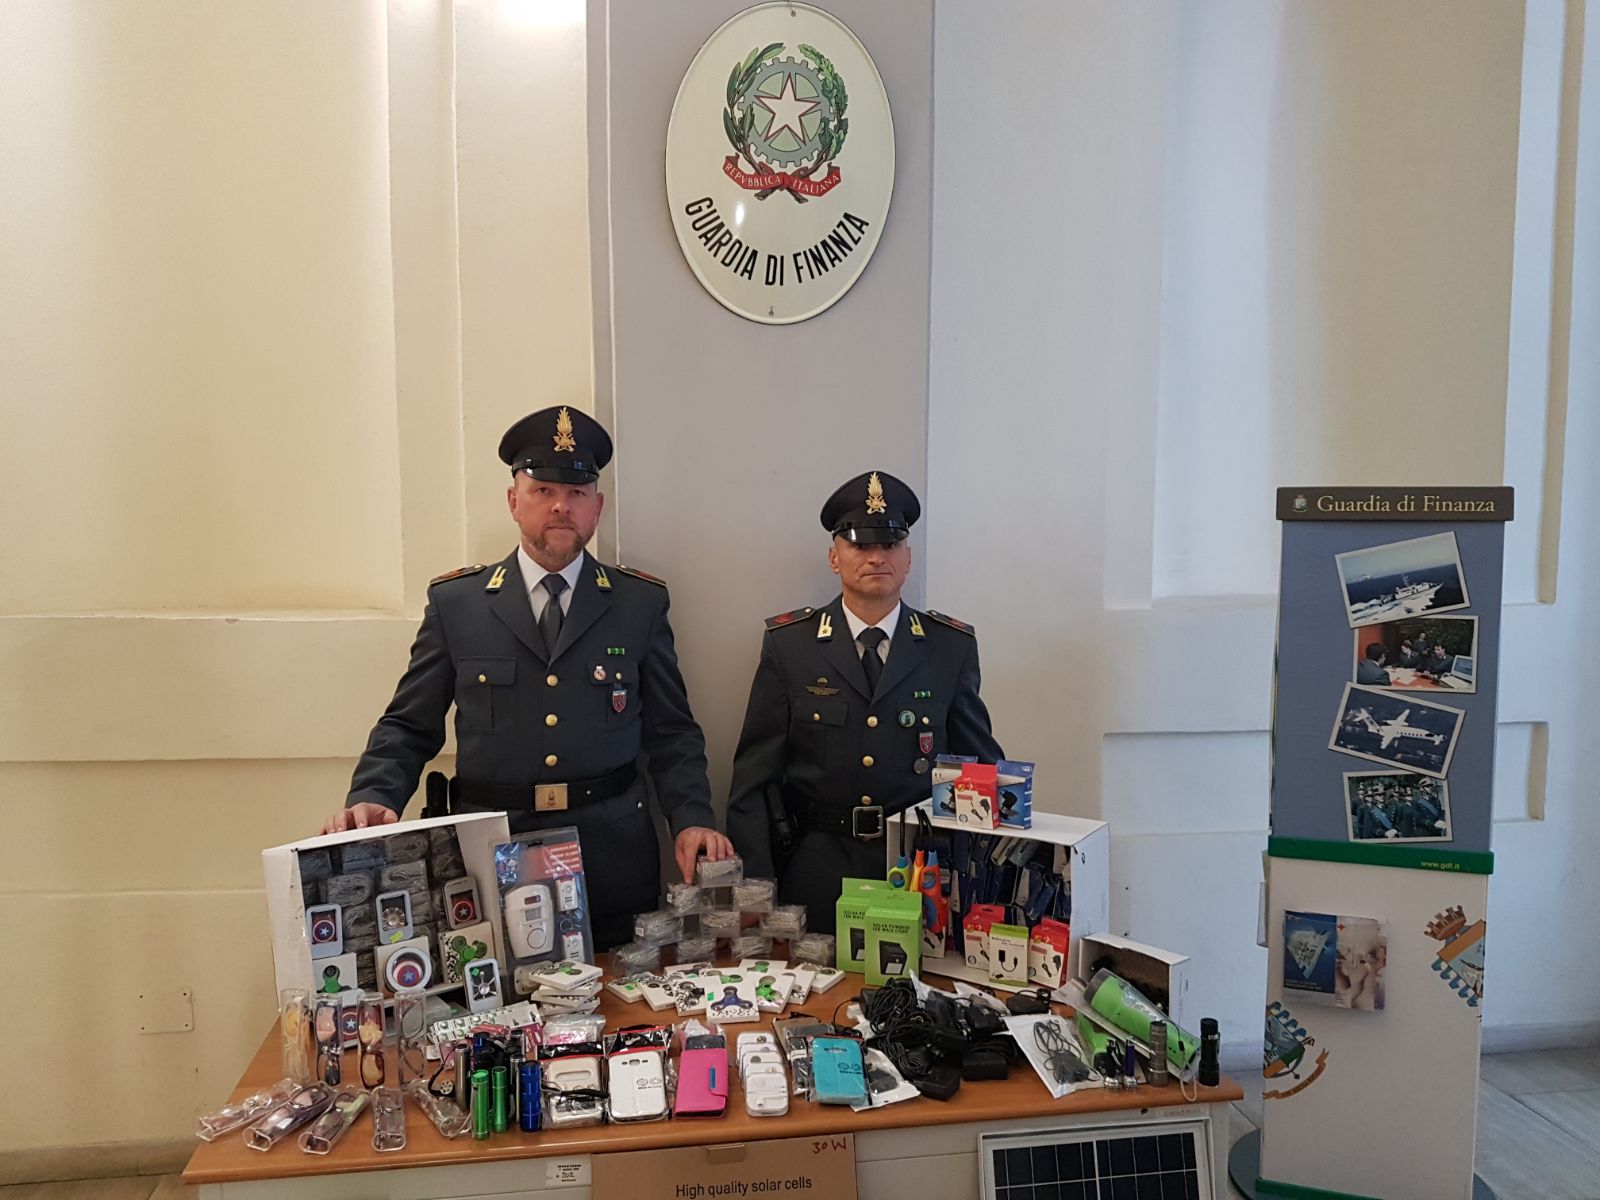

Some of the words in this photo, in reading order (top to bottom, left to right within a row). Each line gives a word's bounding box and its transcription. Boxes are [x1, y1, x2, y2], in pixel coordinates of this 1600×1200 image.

[792, 174, 840, 193] ITALIANA
[685, 197, 758, 280] GUARDIA
[765, 254, 784, 286] DI
[793, 212, 869, 284] FINANZA
[1317, 495, 1391, 512] Guardia
[1397, 495, 1415, 512] di
[1423, 495, 1496, 512] Finanza
[811, 1142, 828, 1154] 30
[676, 1184, 704, 1199] High
[707, 1181, 749, 1196] quality
[751, 1178, 782, 1192] solar
[784, 1177, 813, 1190] cells
